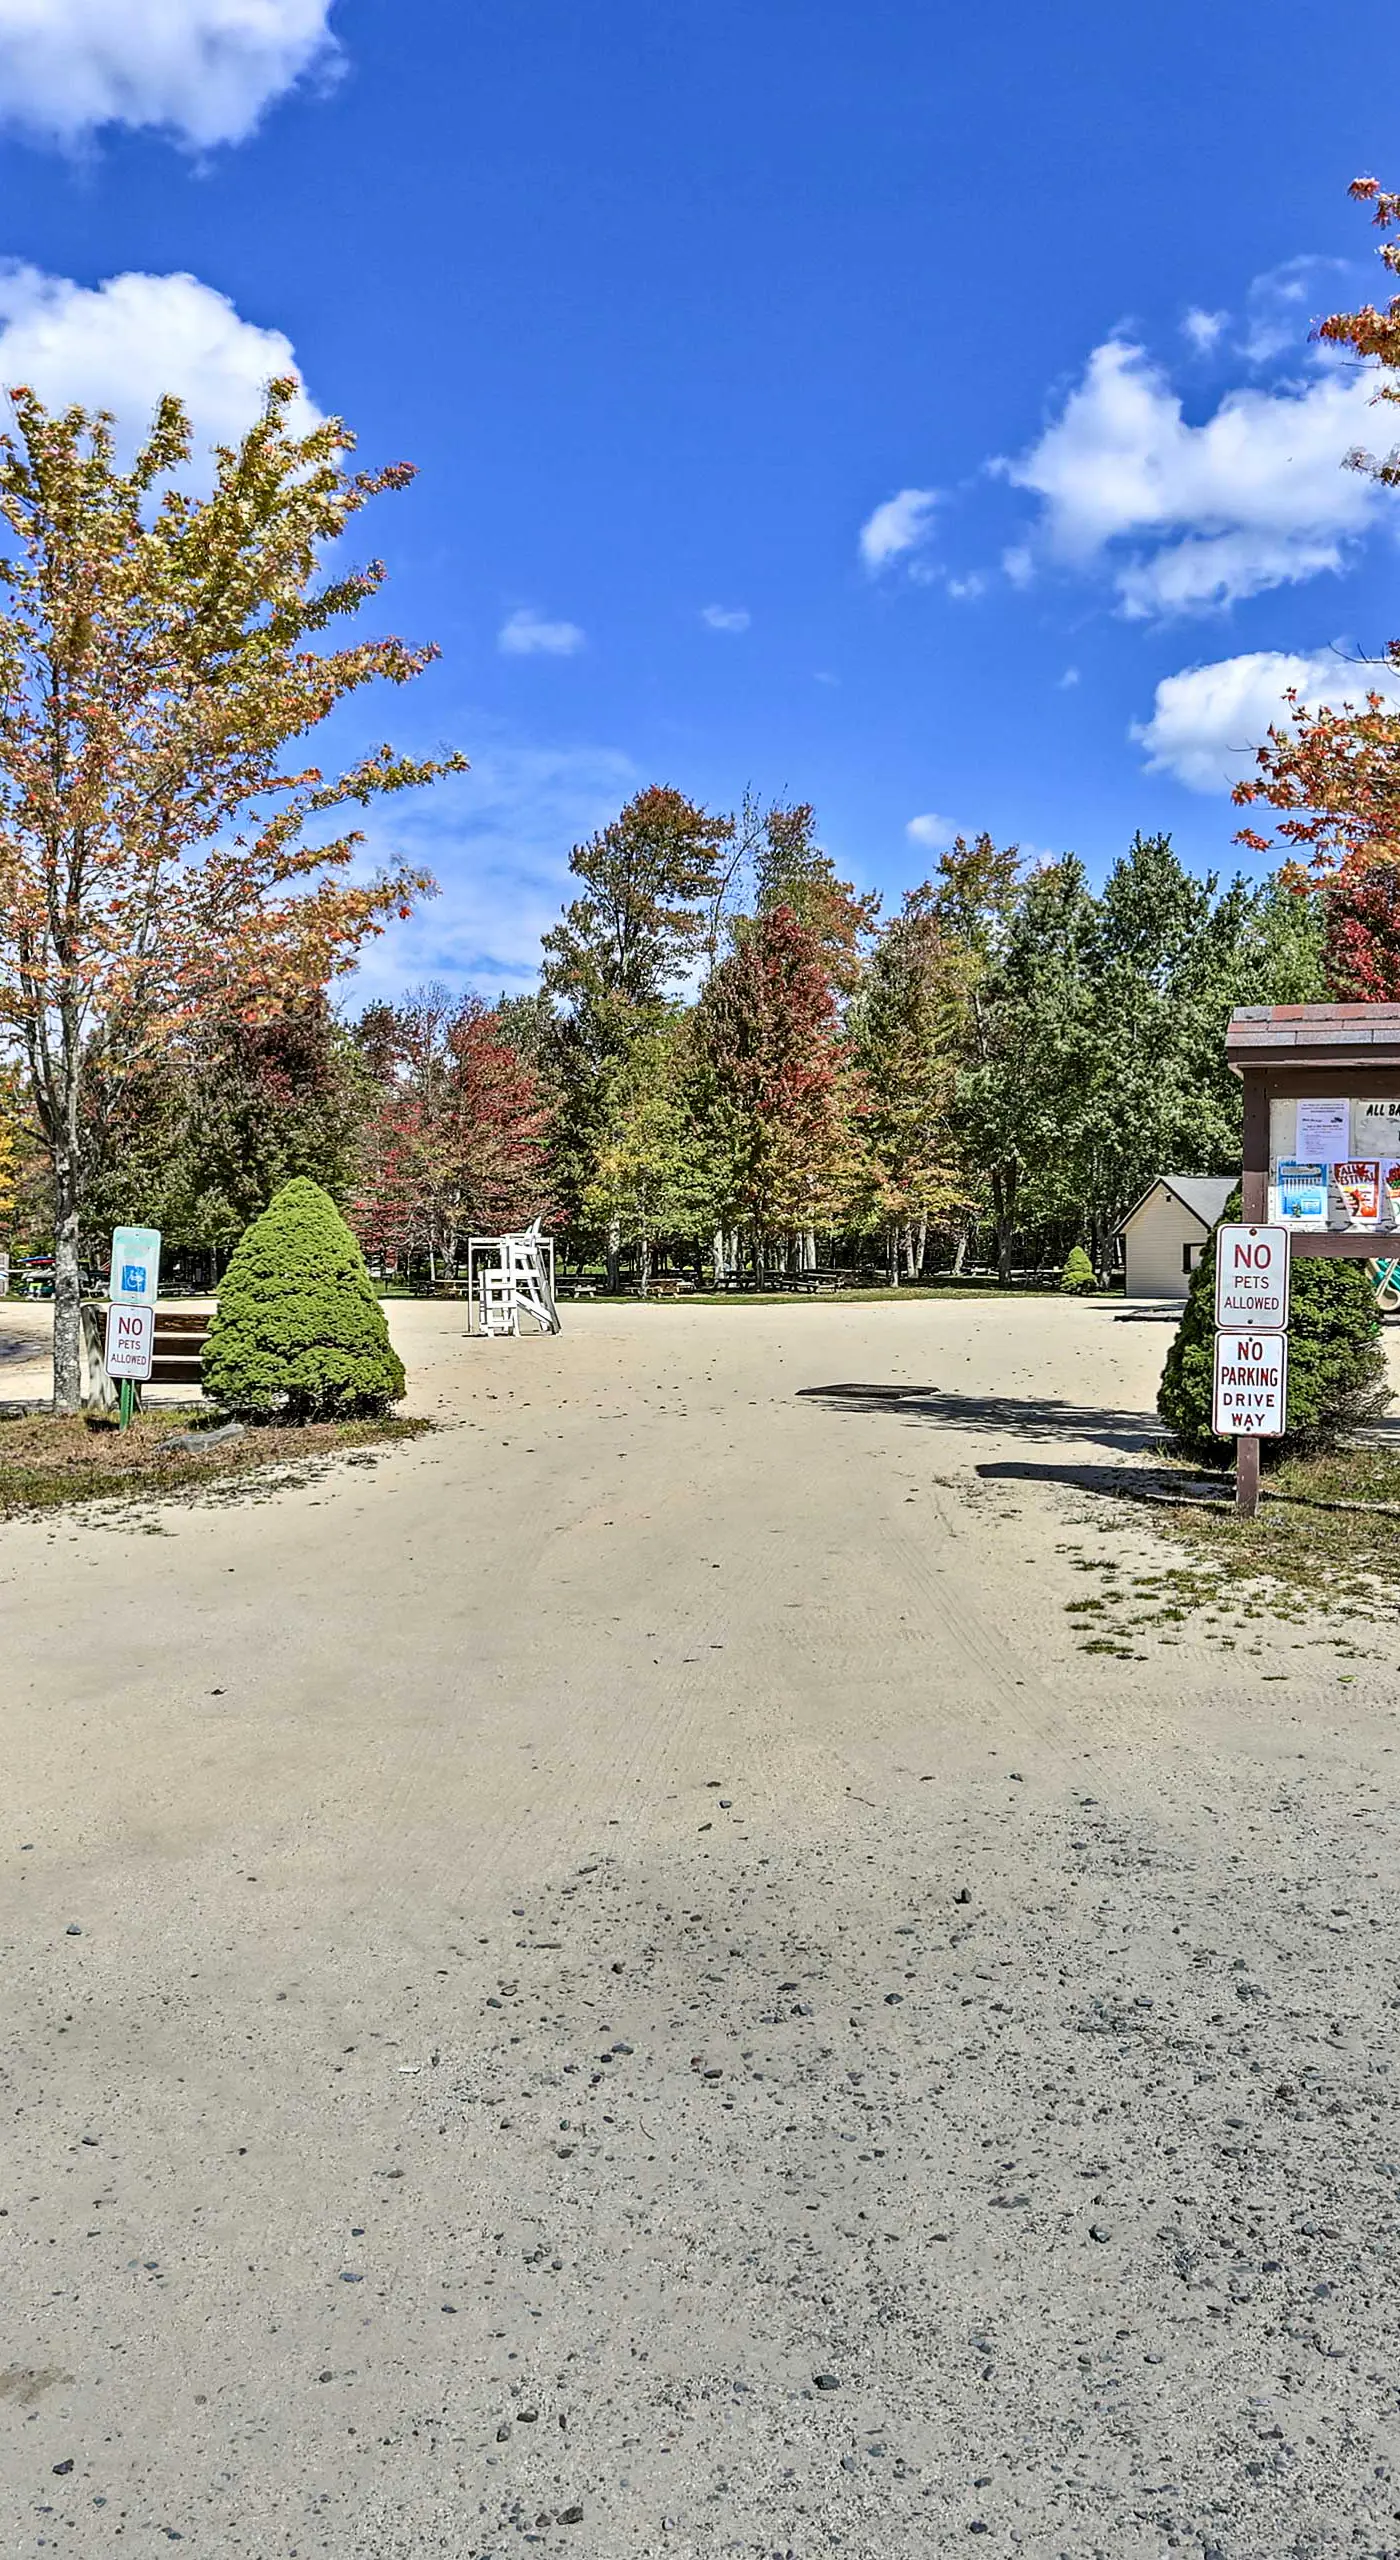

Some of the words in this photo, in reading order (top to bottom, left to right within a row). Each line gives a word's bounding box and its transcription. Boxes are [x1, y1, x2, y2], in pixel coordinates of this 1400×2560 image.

[1366, 1103, 1384, 1116] ALL
[1339, 1171, 1375, 1185] ESTIVAL
[1234, 1244, 1272, 1269] NO
[1235, 1275, 1269, 1290] PETS
[1224, 1296, 1280, 1310] ALLOWED
[118, 1316, 143, 1336] NO
[118, 1339, 141, 1350] PETS
[1237, 1341, 1263, 1361] NO
[110, 1353, 147, 1366] ALLOWED
[1221, 1366, 1278, 1387] PARKING
[1223, 1392, 1275, 1407] DRIVE
[1231, 1413, 1265, 1427] WAY
